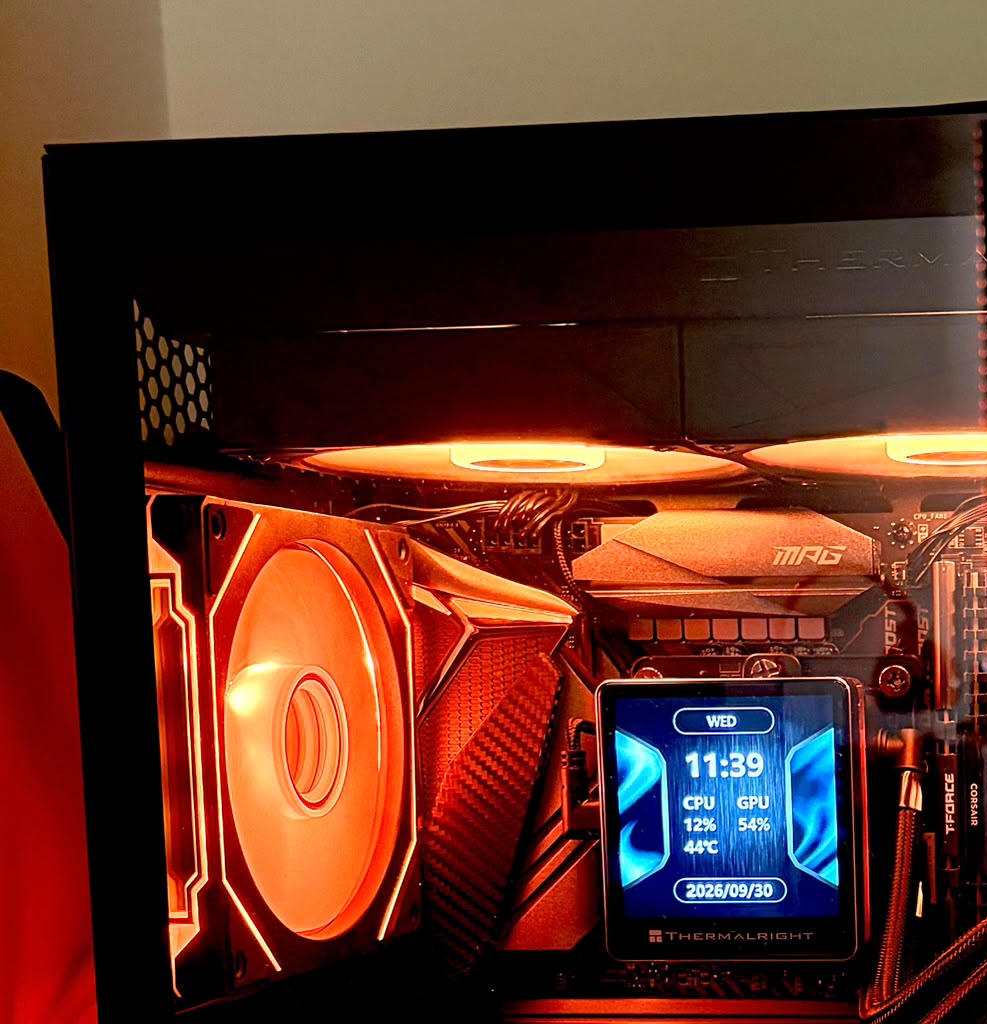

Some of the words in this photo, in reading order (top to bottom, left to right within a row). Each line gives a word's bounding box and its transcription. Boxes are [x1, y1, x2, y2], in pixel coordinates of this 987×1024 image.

[771, 545, 847, 567] MPG
[705, 714, 738, 728] WED
[685, 752, 765, 779] 11:39
[683, 796, 716, 811] CPU
[736, 796, 770, 810] GPU
[970, 783, 978, 827] CORSAIR
[683, 818, 717, 832] 12%
[738, 818, 771, 832] 54%
[686, 884, 774, 899] 2026/09/30
[665, 930, 814, 941] THERMALRIGHT
